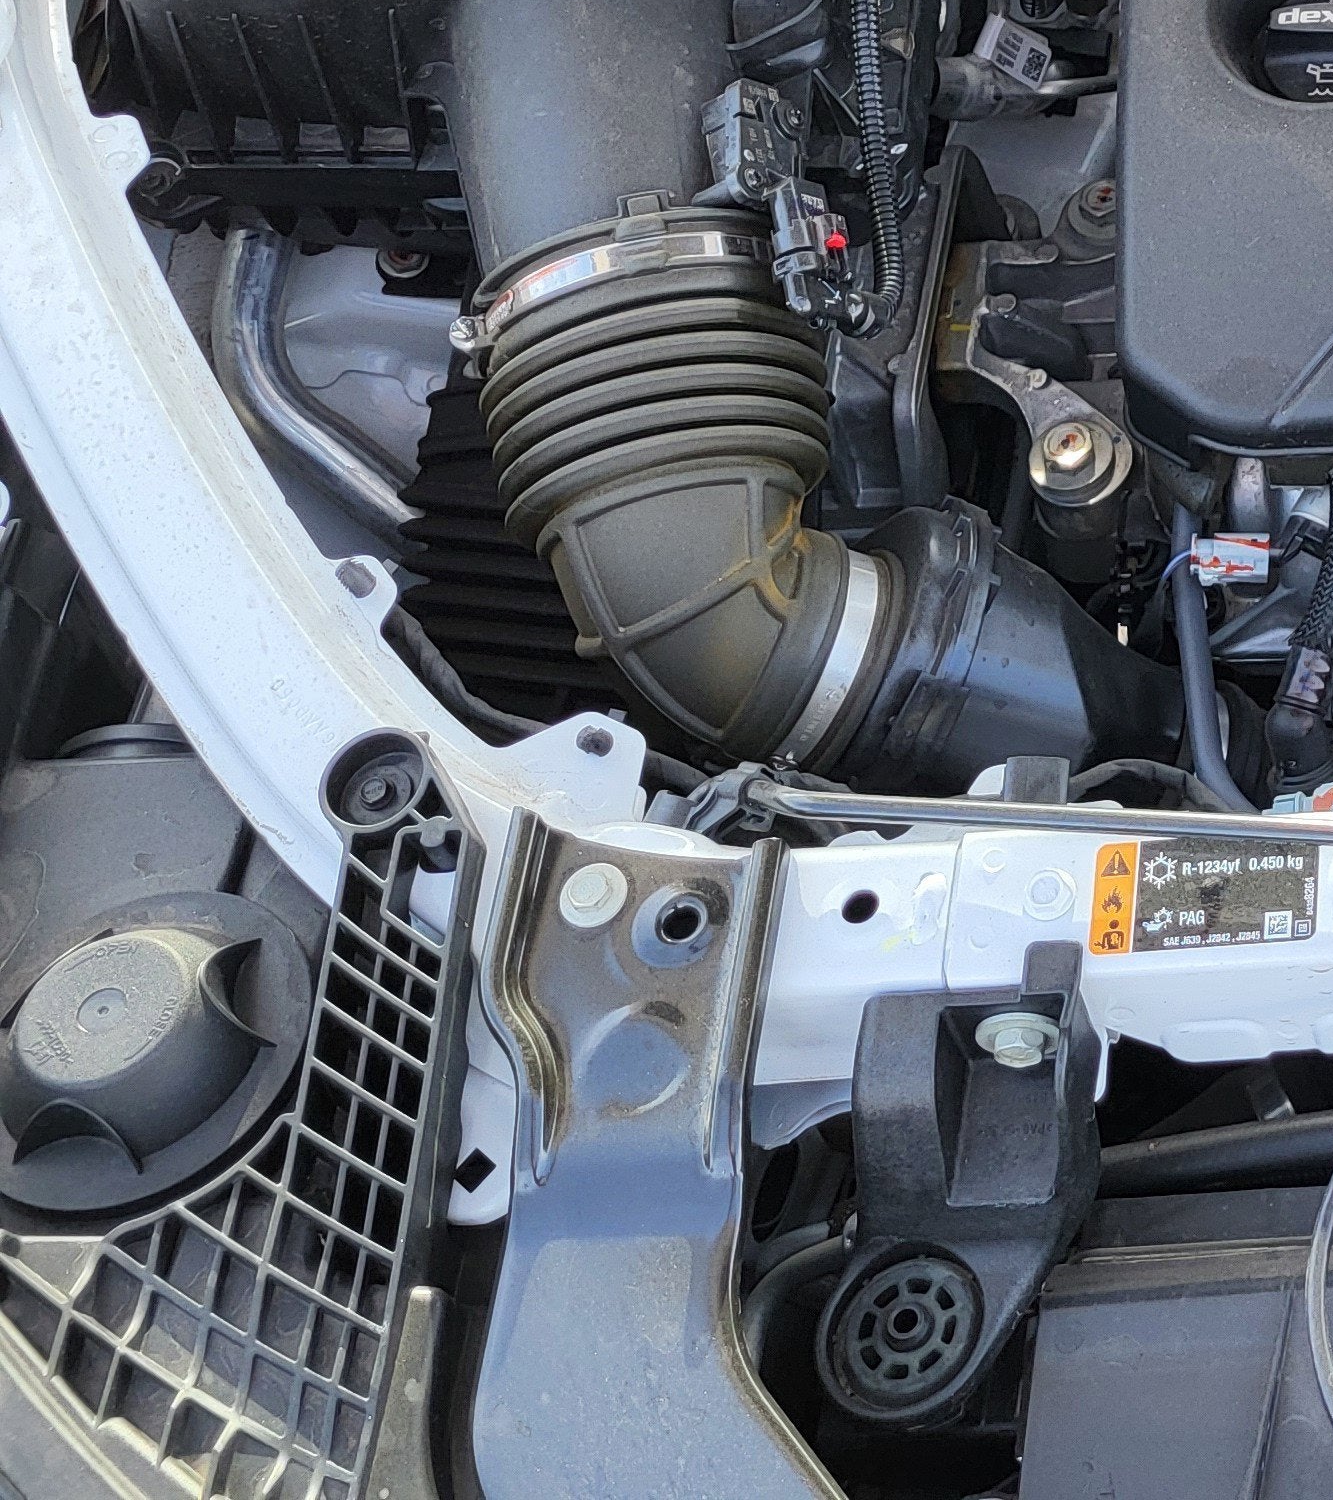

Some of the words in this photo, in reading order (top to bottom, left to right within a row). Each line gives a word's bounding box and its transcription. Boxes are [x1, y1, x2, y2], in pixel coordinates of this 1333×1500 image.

[1181, 856, 1241, 877] R-1234yf
[1248, 855, 1285, 871] 0.450
[1286, 854, 1304, 871] kg
[1178, 909, 1206, 927] PAG
[1162, 936, 1180, 947] SAE
